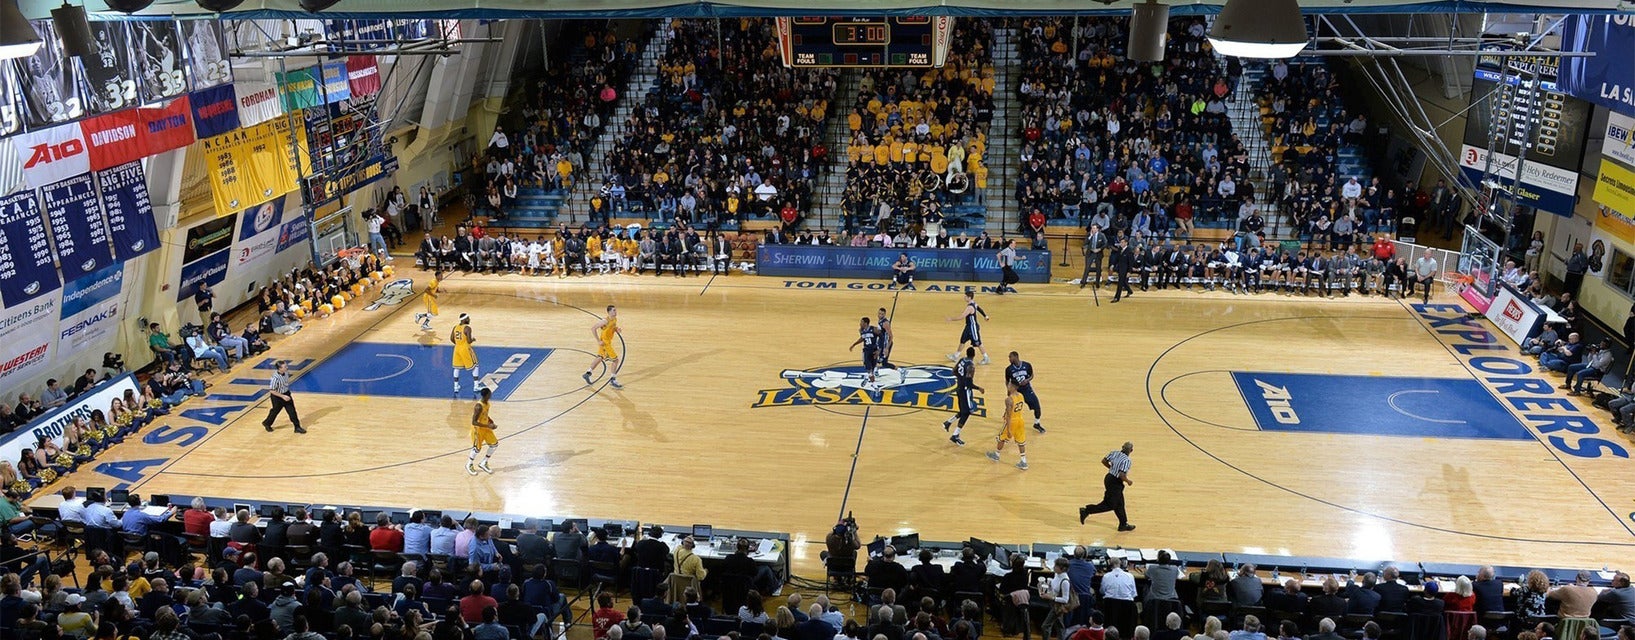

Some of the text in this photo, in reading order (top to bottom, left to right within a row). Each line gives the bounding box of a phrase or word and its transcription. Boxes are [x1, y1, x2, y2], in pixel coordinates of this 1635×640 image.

[847, 27, 885, 41] 3:00
[207, 60, 231, 82] 23
[106, 80, 137, 109] 32
[241, 87, 276, 108] FORDHAM
[1600, 82, 1620, 101] LA
[51, 97, 84, 122] 22
[147, 113, 187, 134] DAYTON
[1607, 125, 1628, 141] IBEW
[91, 124, 136, 147] DAVIDSON
[24, 138, 84, 170] A10
[101, 165, 142, 187] BIG FIVE
[1527, 164, 1541, 178] Holy
[1541, 167, 1575, 184] Redeemer
[1517, 187, 1541, 201] Glaser
[773, 252, 826, 265] SHERWIN
[836, 254, 890, 267] WILLIAMS
[910, 255, 962, 269] SHERWIN
[973, 256, 1029, 271] WILLMS
[63, 275, 114, 303] Independence
[783, 280, 838, 288] TOM
[0, 310, 32, 330] Citizens
[33, 299, 54, 315] Bank
[61, 310, 108, 339] FESNAK
[4, 343, 48, 371] WESTERN
[1409, 302, 1629, 460] EXPLORERS
[1253, 378, 1301, 425] A10
